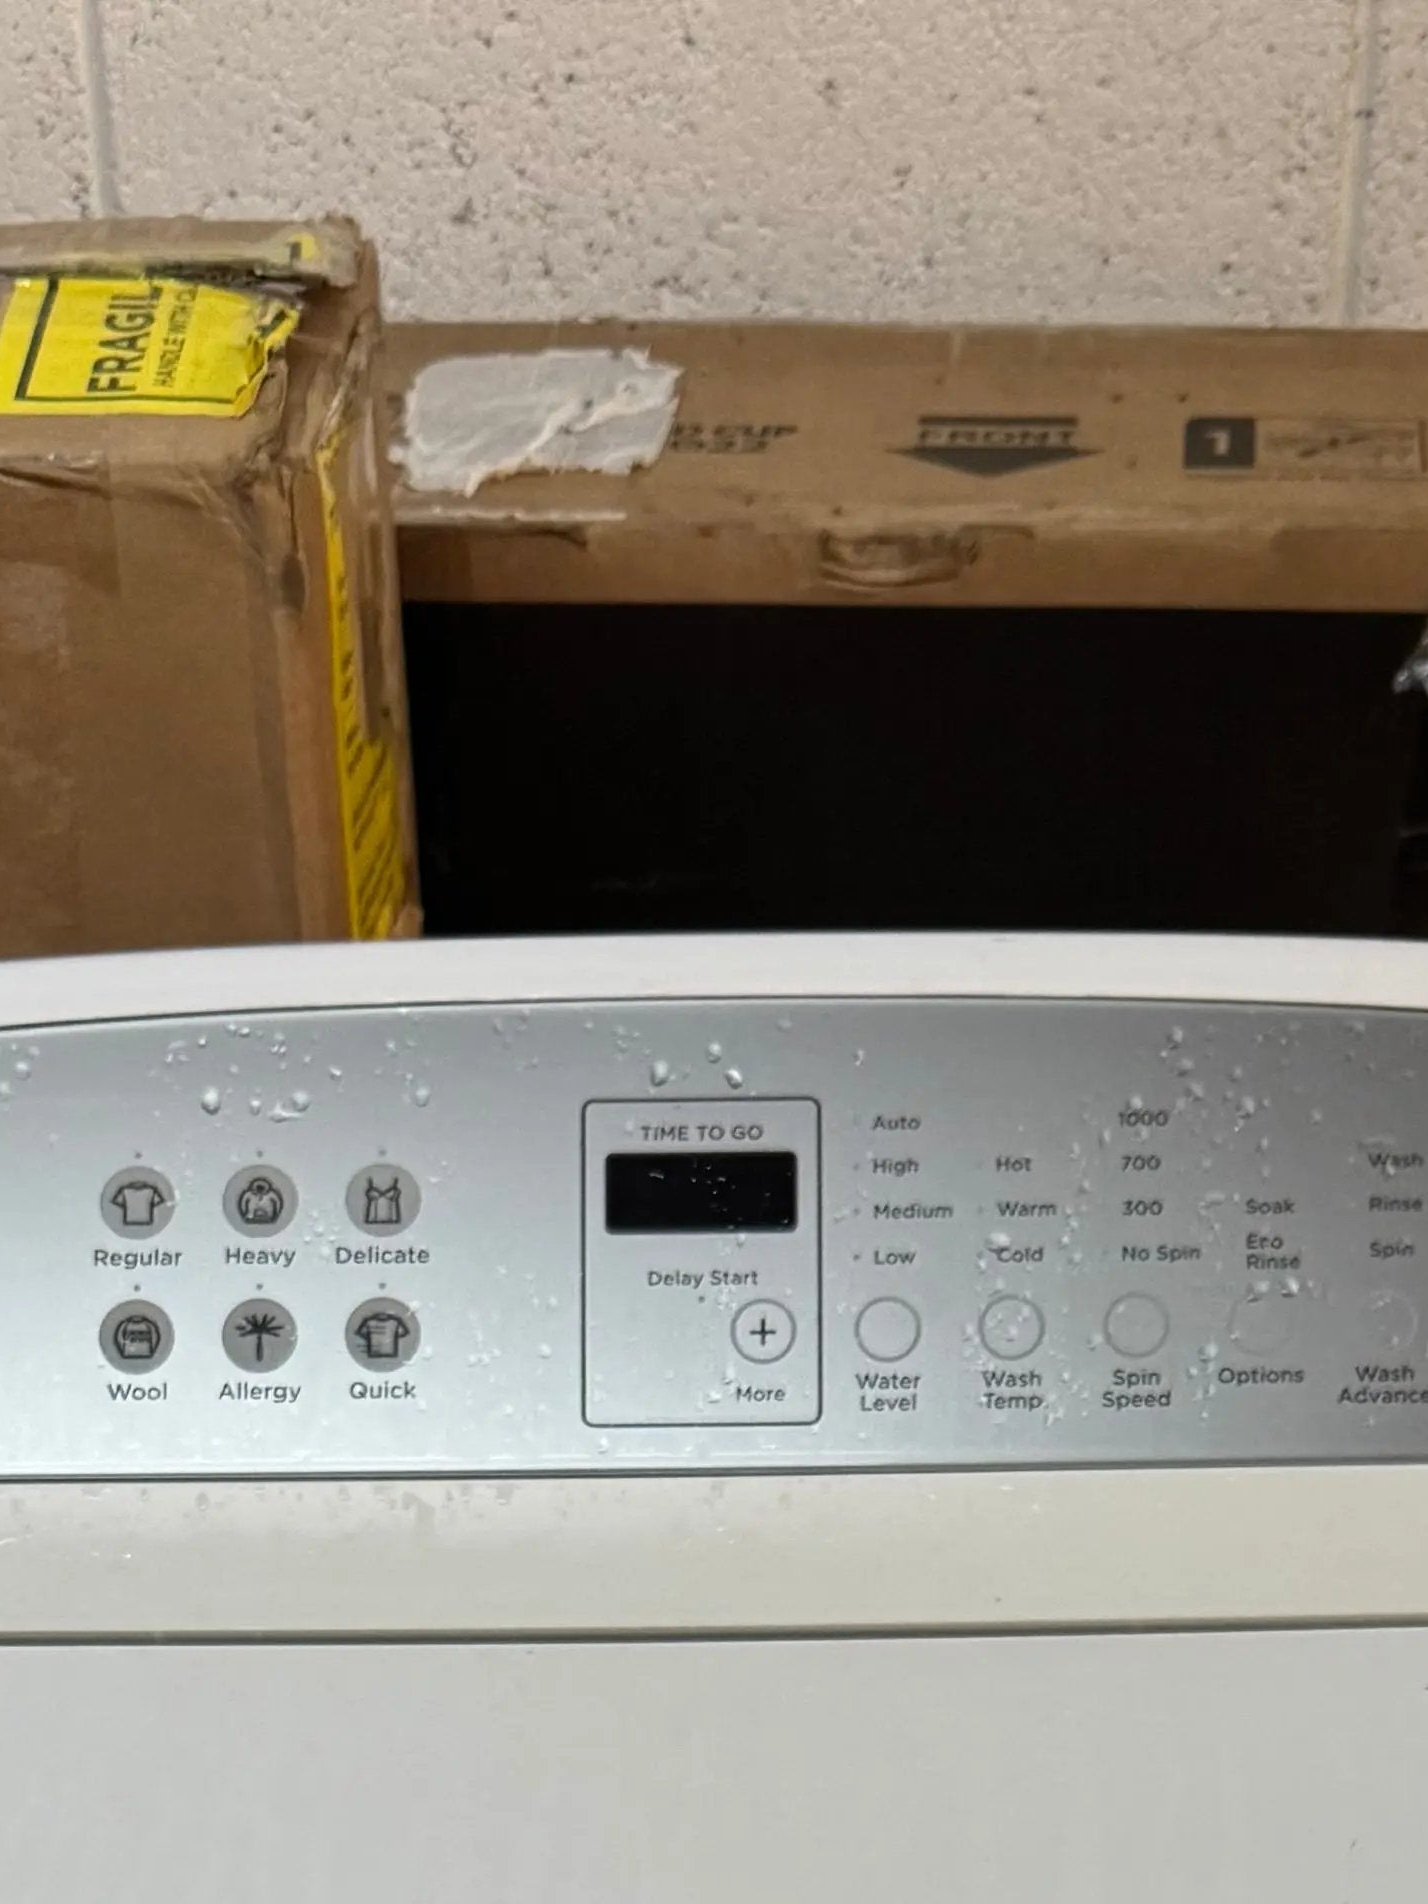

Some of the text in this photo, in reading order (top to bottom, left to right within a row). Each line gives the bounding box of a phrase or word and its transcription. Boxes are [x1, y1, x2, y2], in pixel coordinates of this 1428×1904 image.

[87, 283, 164, 392] FRAGIL
[152, 337, 188, 388] HANDLE
[1204, 430, 1233, 457] 1
[872, 1115, 921, 1131] Auto
[1118, 1110, 1169, 1128] 1000
[641, 1124, 764, 1141] TIME TO GO
[872, 1157, 920, 1176] High
[995, 1156, 1032, 1172] Hot
[1121, 1155, 1161, 1171] 700
[1368, 1151, 1424, 1168] Wash
[873, 1202, 954, 1220] Medium
[997, 1201, 1058, 1218] Warm
[1122, 1200, 1163, 1216] 300
[1246, 1198, 1295, 1215] Soak
[1369, 1196, 1422, 1212] Rinse
[1246, 1233, 1284, 1251] Eco
[1369, 1241, 1415, 1259] Spin
[93, 1249, 182, 1269] Regular
[225, 1248, 296, 1267] Heavy
[335, 1246, 430, 1265] Delicate
[873, 1249, 916, 1265] Low
[996, 1246, 1044, 1263] Cold
[1121, 1244, 1201, 1264] No Spin
[1246, 1253, 1301, 1270] Rinse
[647, 1269, 759, 1289] Delay Start
[854, 1372, 921, 1390] Water
[981, 1370, 1043, 1388] Wash
[1112, 1369, 1161, 1388] Spin
[1218, 1367, 1304, 1385] Options
[1355, 1365, 1415, 1383] Wash
[106, 1383, 168, 1401] Wool
[219, 1382, 302, 1403] Allergy
[349, 1381, 416, 1400] Quick
[735, 1386, 786, 1403] More
[860, 1394, 918, 1411] Level
[1102, 1390, 1171, 1410] Speed
